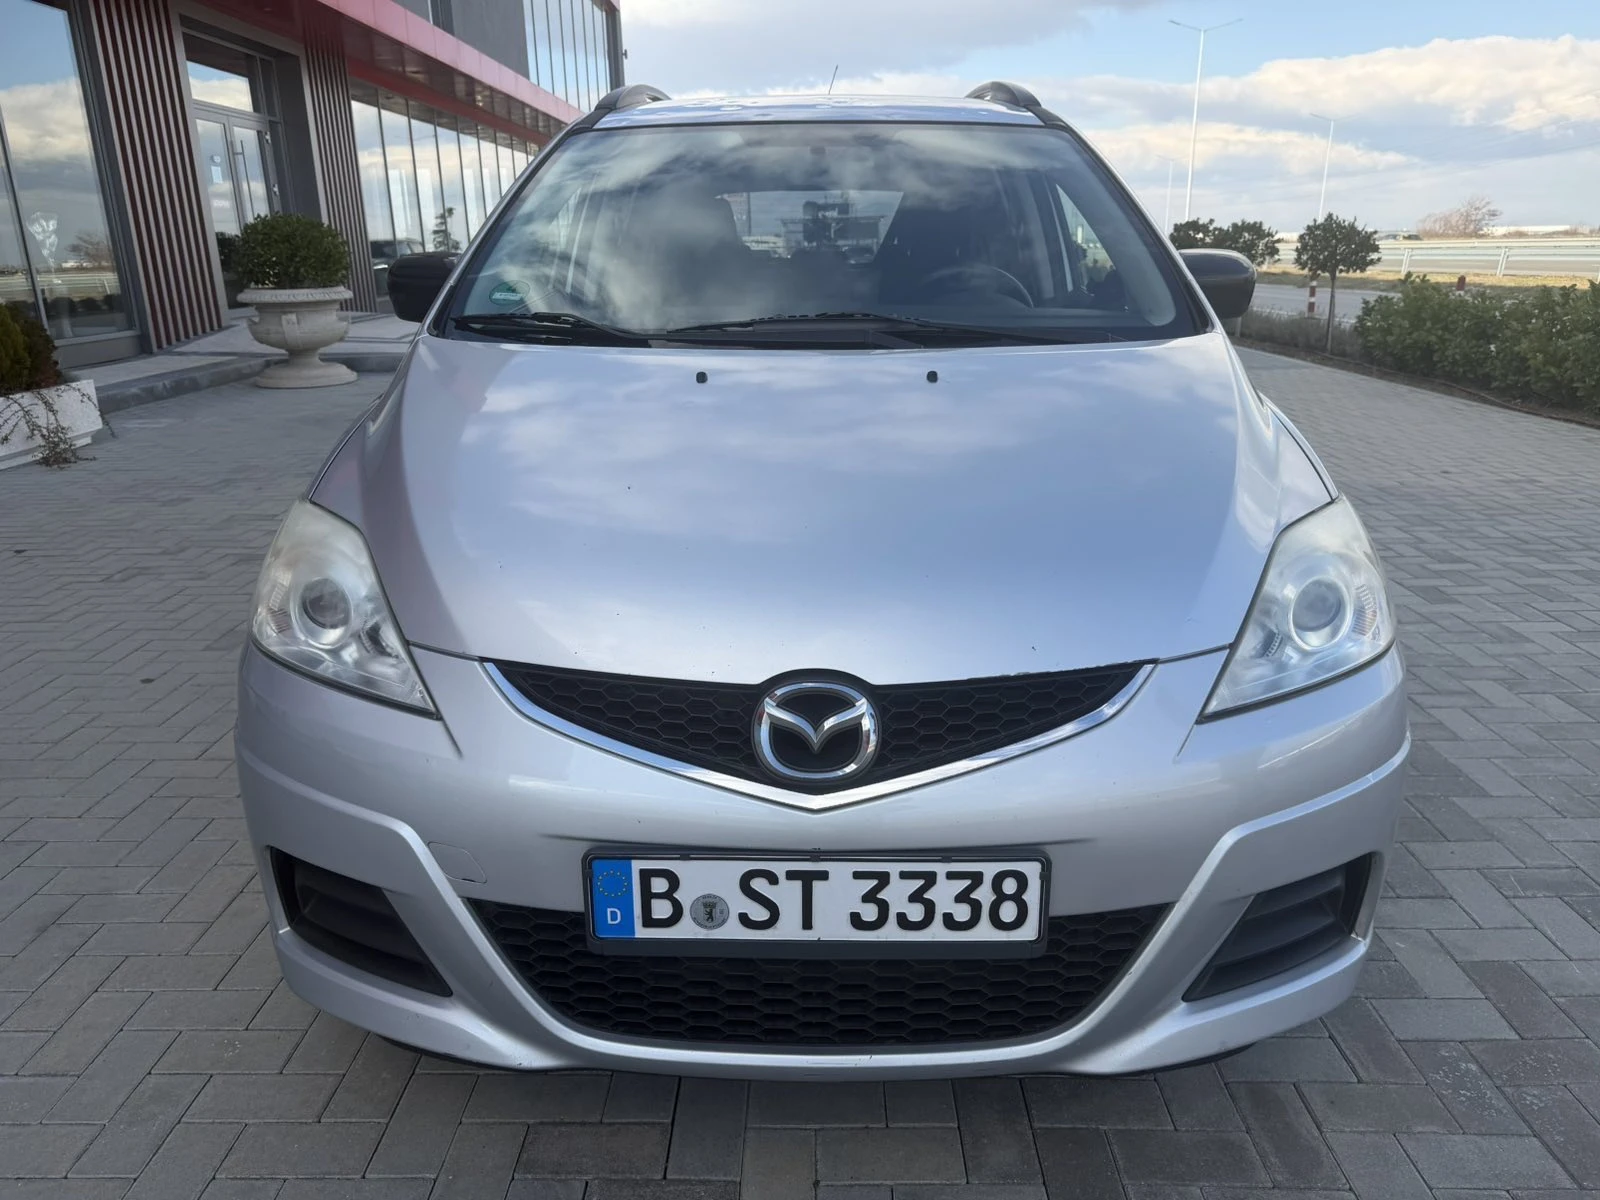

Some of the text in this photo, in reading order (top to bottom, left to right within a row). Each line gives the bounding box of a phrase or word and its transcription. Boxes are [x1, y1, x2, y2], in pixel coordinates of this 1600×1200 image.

[607, 907, 621, 925] D
[639, 868, 1029, 932] B ST 3338
